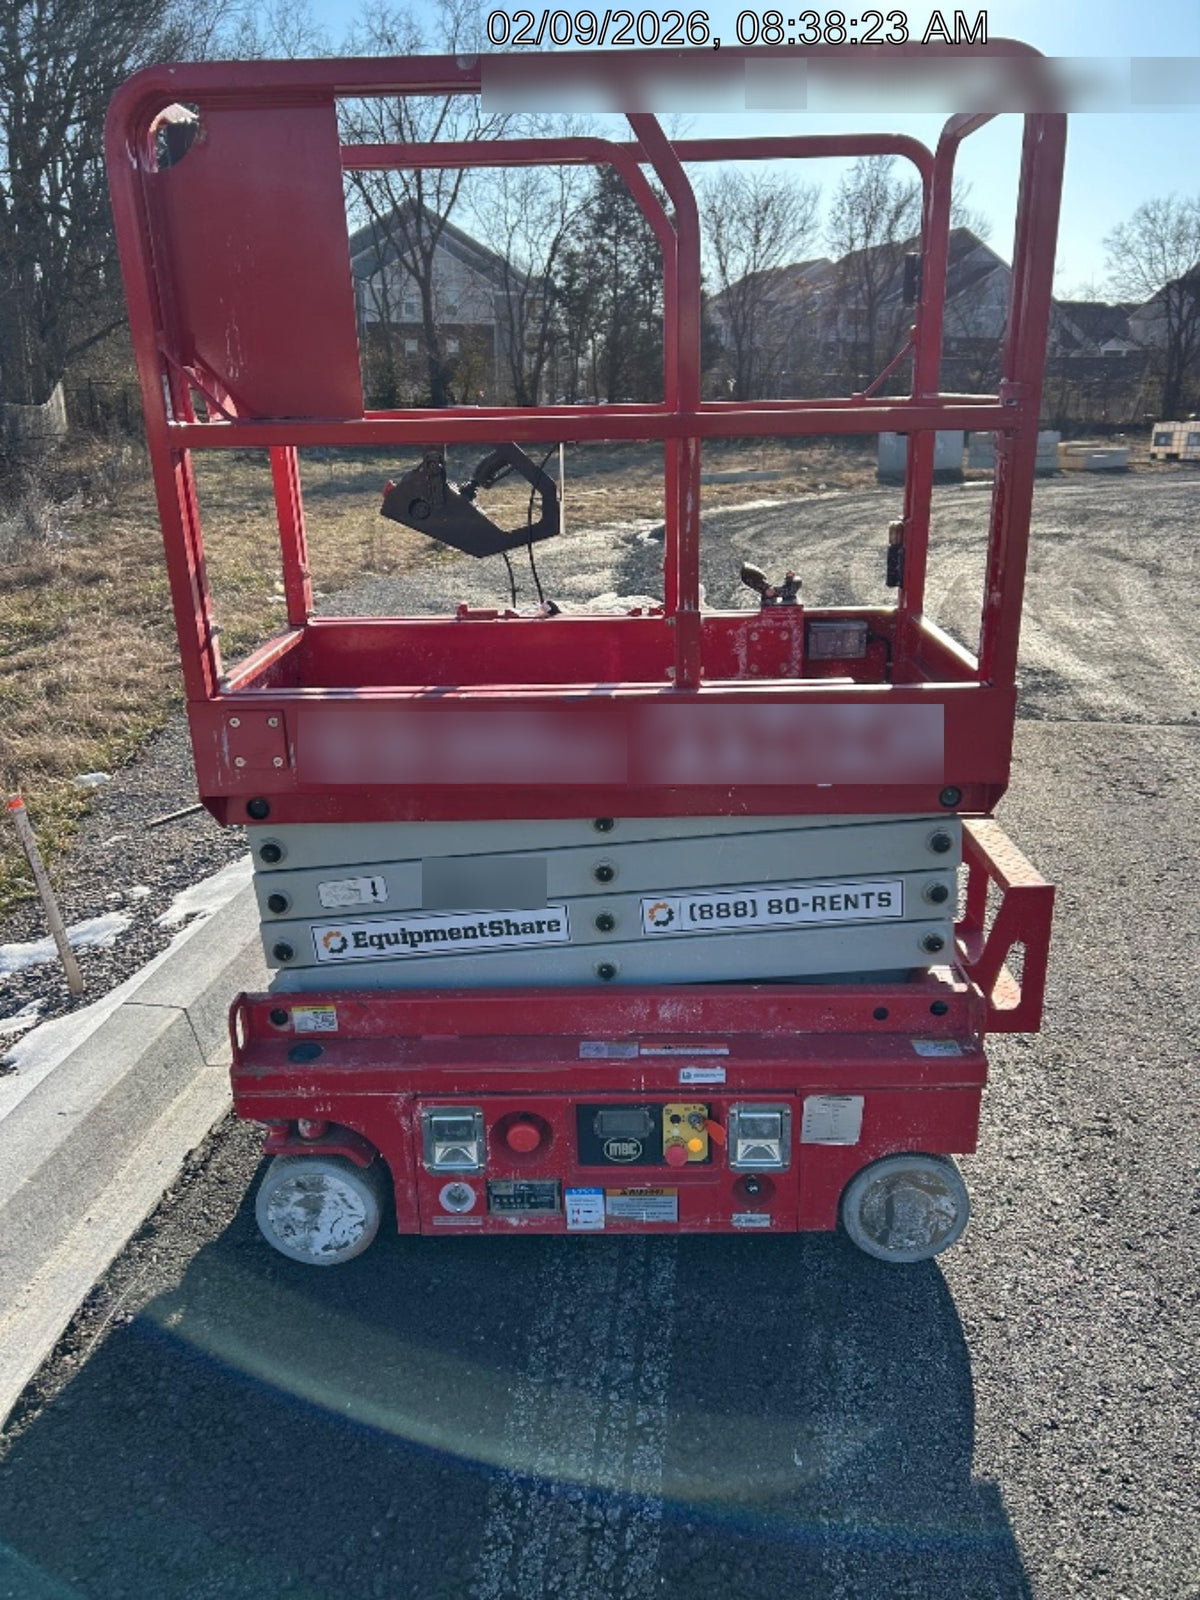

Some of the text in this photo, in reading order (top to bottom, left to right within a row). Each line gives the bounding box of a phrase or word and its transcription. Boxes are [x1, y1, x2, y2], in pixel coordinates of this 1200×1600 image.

[689, 892, 892, 922] (888) 80-RENTS
[352, 918, 561, 950] EquipmentShare
